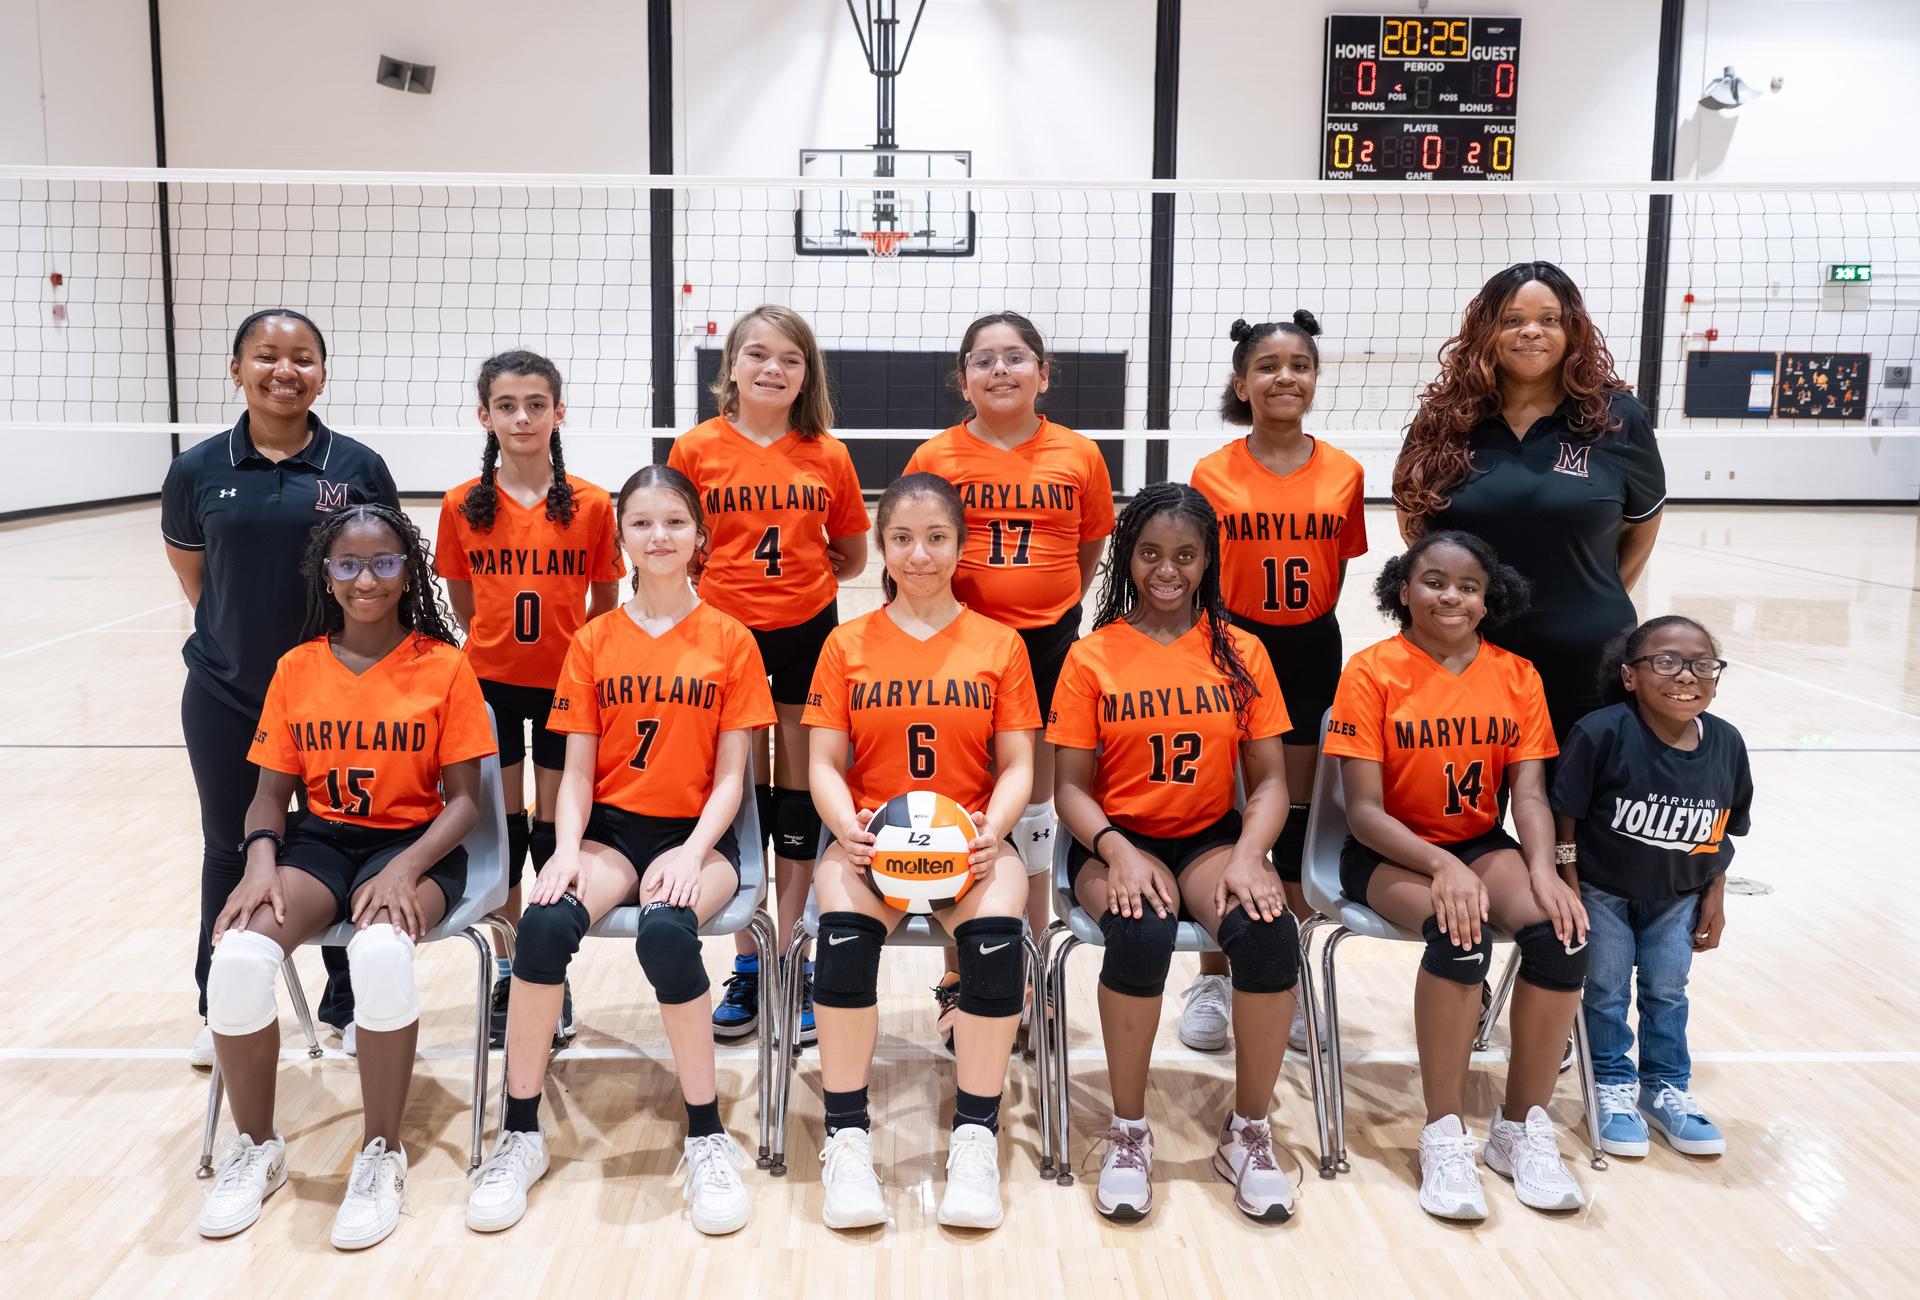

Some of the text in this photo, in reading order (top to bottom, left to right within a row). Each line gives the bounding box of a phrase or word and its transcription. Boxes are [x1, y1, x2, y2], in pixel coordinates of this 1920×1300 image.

[1335, 44, 1376, 59] HOME
[1383, 20, 1468, 56] 20:25
[1403, 62, 1445, 72] PERIOD
[1471, 46, 1517, 61] GUEST
[1357, 61, 1377, 96] 0
[1495, 63, 1515, 98] 0
[1351, 102, 1386, 111] BONUS
[1388, 93, 1407, 101] POSS
[1439, 93, 1459, 102] POSS
[1459, 103, 1494, 112] BONUS
[1327, 123, 1359, 132] FOULS
[1403, 124, 1438, 133] PLAYER
[1484, 125, 1515, 134] FOULS
[1334, 134, 1354, 169] 0
[1360, 140, 1374, 162] 2
[1422, 135, 1442, 170] 0
[1467, 142, 1481, 164] 2
[1492, 136, 1512, 171] 0
[1328, 171, 1353, 180] WON
[1355, 164, 1377, 172] T.O.L.
[1405, 172, 1433, 180] GAME
[1462, 165, 1484, 173] T.O.L.
[1555, 442, 1591, 473] M
[316, 479, 349, 507] M
[706, 484, 826, 514] MARYLAND
[752, 525, 783, 578] 4
[986, 518, 1034, 567] 17
[469, 549, 587, 575] MARYLAND
[1261, 556, 1311, 612] 16
[513, 590, 542, 645] 0
[850, 679, 992, 710] MARYLAND
[1101, 684, 1238, 723] MARYLAN
[628, 718, 661, 771] 7
[1395, 716, 1520, 748] MARYLAND
[905, 722, 937, 781] 6
[1147, 731, 1204, 785] 12
[325, 766, 377, 818] 15
[1443, 760, 1485, 817] 14
[1648, 793, 1715, 808] MARYLAND
[908, 832, 931, 846] L2
[886, 857, 954, 875] molten
